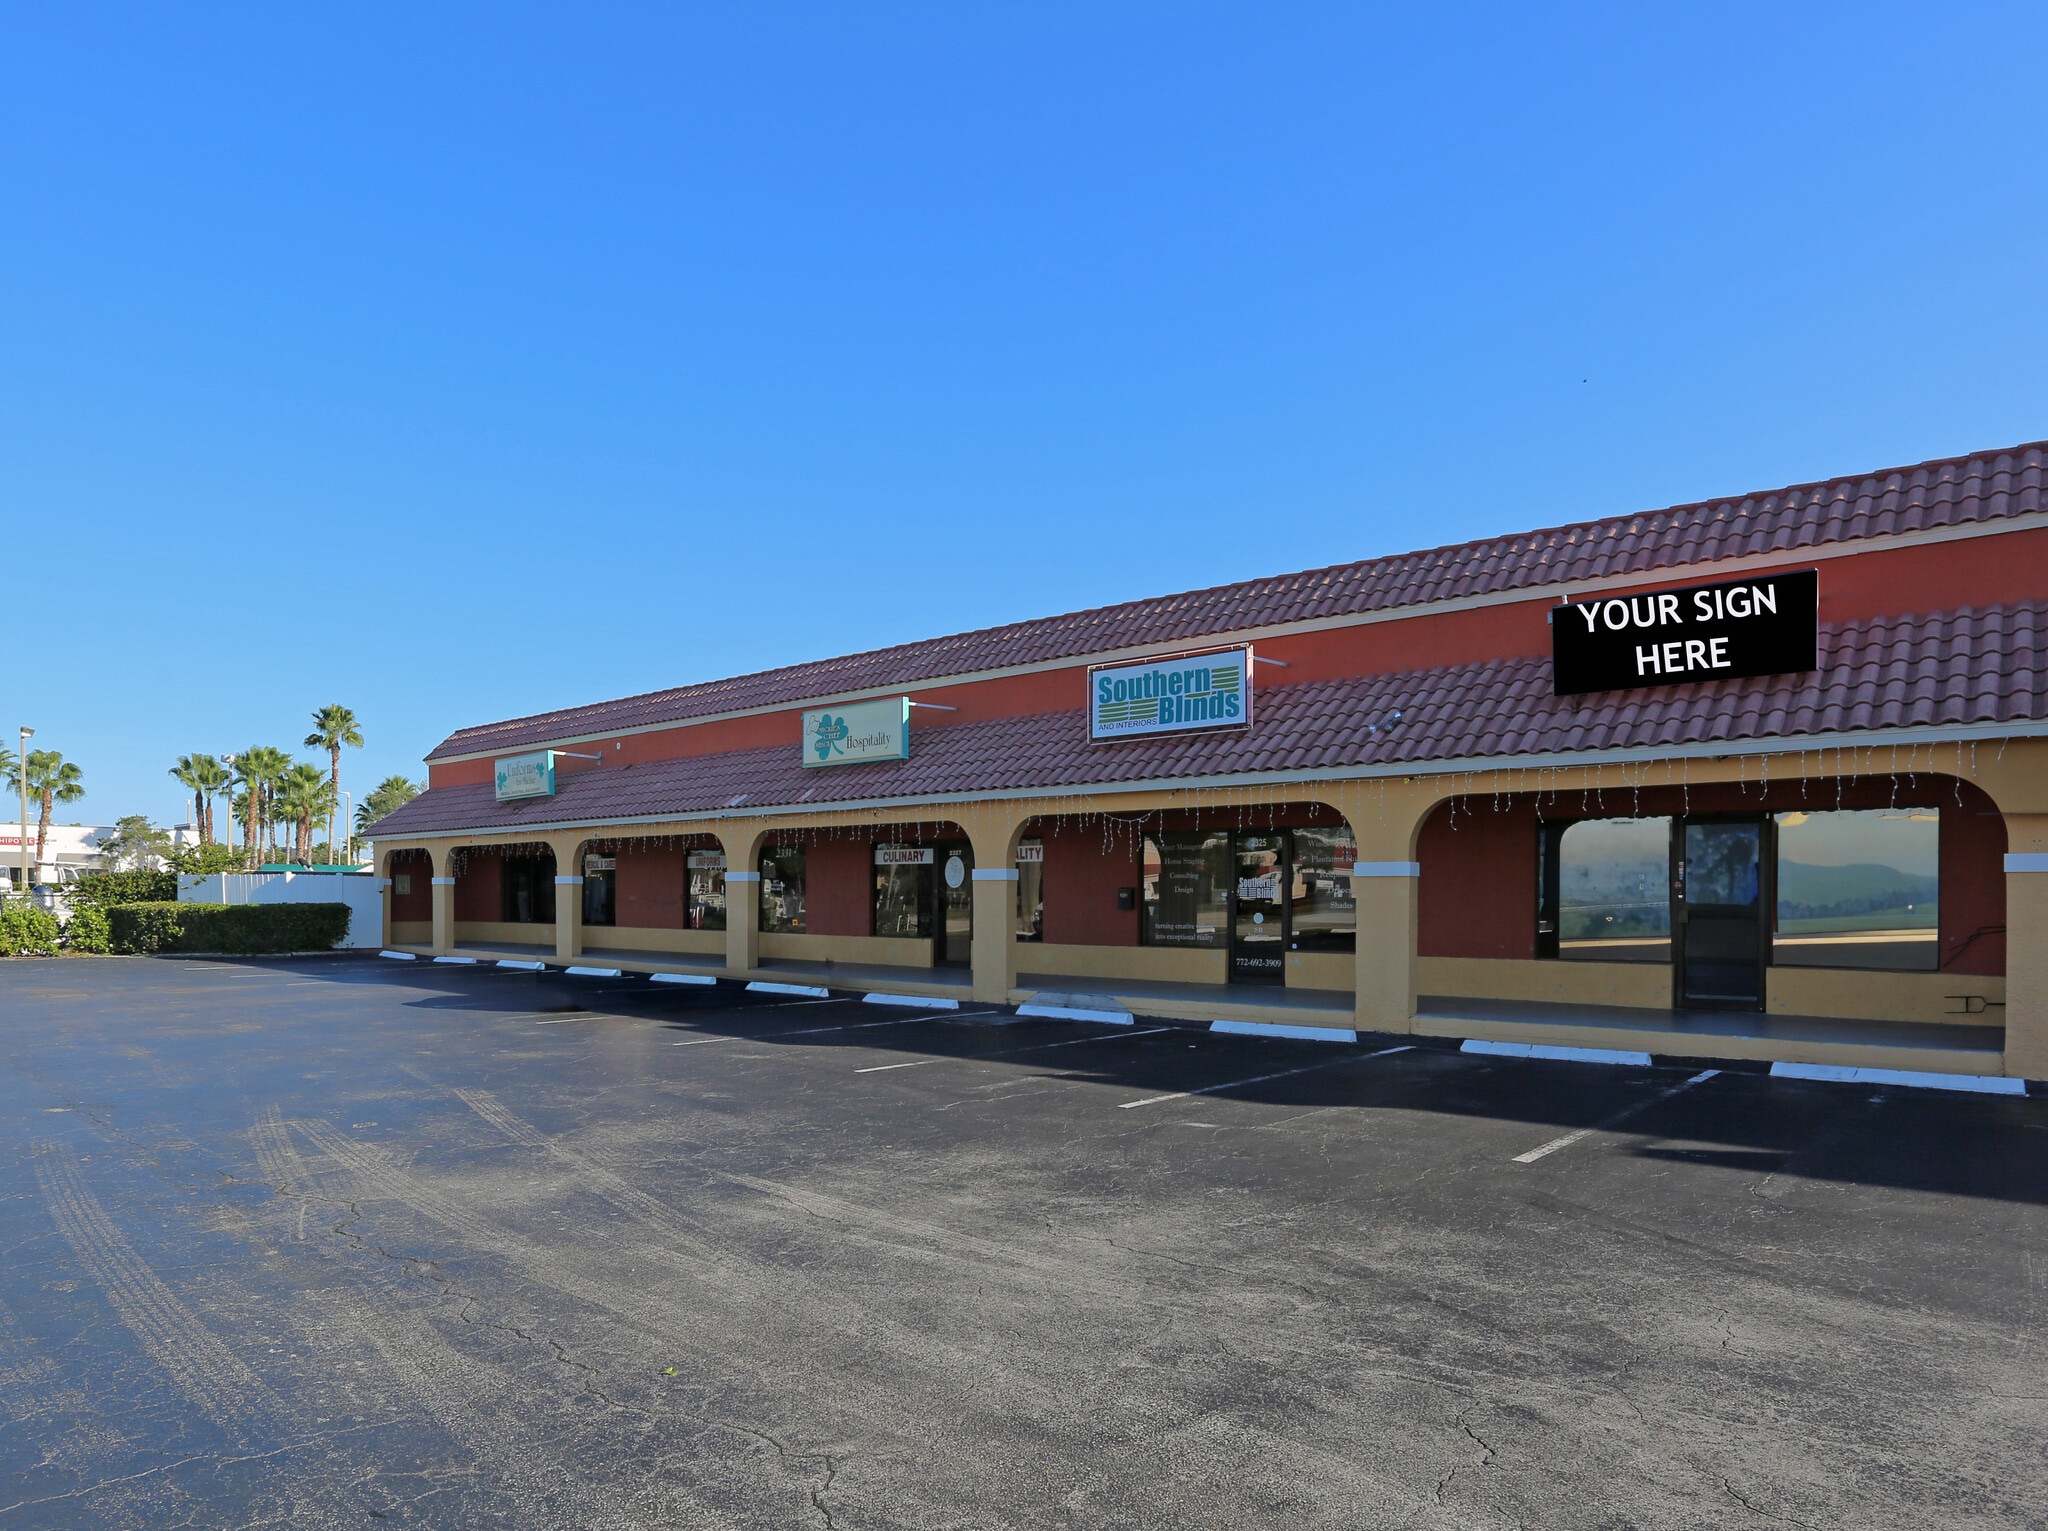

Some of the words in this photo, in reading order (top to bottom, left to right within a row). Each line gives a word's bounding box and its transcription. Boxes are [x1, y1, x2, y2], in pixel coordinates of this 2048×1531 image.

[1577, 594, 1683, 633] YOUR
[1693, 584, 1777, 622] SIGN
[1635, 637, 1731, 676] HERE
[1098, 667, 1210, 703] Southern
[1158, 690, 1240, 724] Blinds
[1098, 723, 1115, 731] AND
[1115, 718, 1157, 729] INTERIORS
[846, 732, 891, 751] Hospitality
[507, 761, 536, 777] Uniforms
[695, 856, 721, 867] UNIFORMS
[883, 850, 925, 863] CULINARY
[1183, 857, 1205, 866] Staging
[1169, 872, 1200, 880] Consulting
[1239, 877, 1271, 888] Southern
[1174, 886, 1194, 894] Design
[1330, 901, 1353, 909] Shades
[1166, 933, 1196, 942] exceptional
[1196, 933, 1214, 942] reality
[1236, 958, 1281, 968] 772-692-3909
